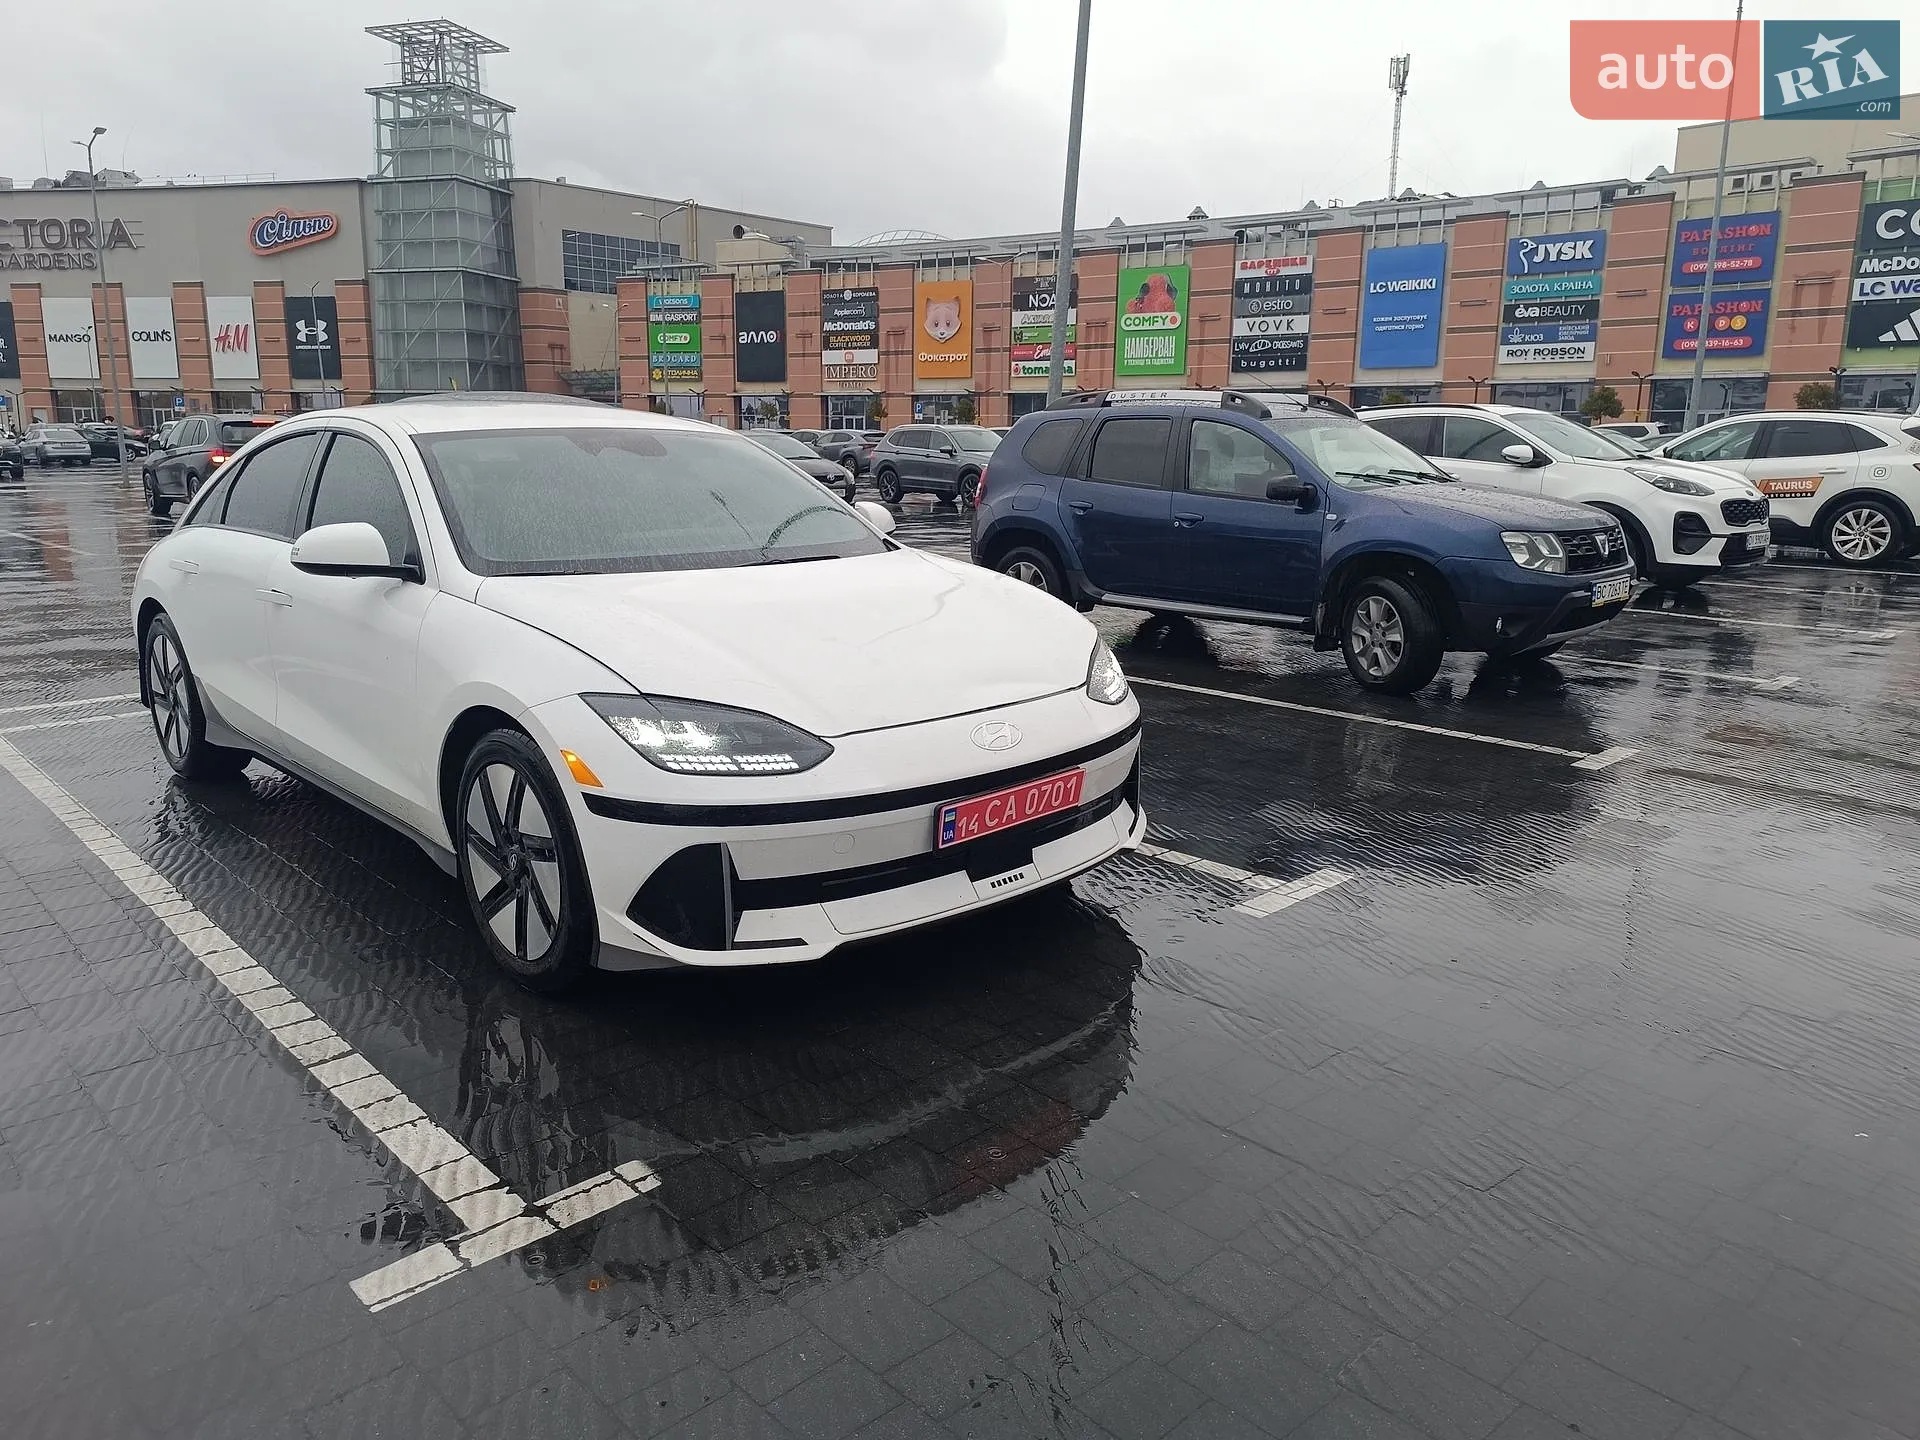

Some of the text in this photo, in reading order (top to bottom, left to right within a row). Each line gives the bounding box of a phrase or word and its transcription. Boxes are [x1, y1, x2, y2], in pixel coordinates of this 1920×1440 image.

[255, 213, 333, 248] Сільпо
[1533, 240, 1594, 263] JYSK
[1859, 255, 1920, 274] McDo
[1243, 279, 1300, 294] MOHITO
[1511, 283, 1550, 294] ЗОЛОТА
[1858, 281, 1887, 297] LC
[1263, 299, 1293, 311] estro
[823, 320, 876, 331] McDonald's
[1124, 315, 1169, 327] COMFY
[1247, 318, 1295, 333] VOVK
[48, 333, 91, 343] MANGO
[132, 329, 172, 342] COLIN'S
[214, 323, 249, 353] H&M
[829, 334, 871, 342] BLACKWOOD
[1124, 336, 1176, 359] НАМБЕРВАН
[1506, 346, 1586, 357] ROY ROBSON
[918, 352, 968, 363] Фокстрот
[1240, 357, 1296, 368] bugatti
[825, 365, 877, 378] IMPERO
[1110, 392, 1169, 400] DUSTER
[1769, 480, 1813, 490] TAURUS
[958, 776, 1077, 838] 14 CA 0701
[943, 830, 954, 841] UA
